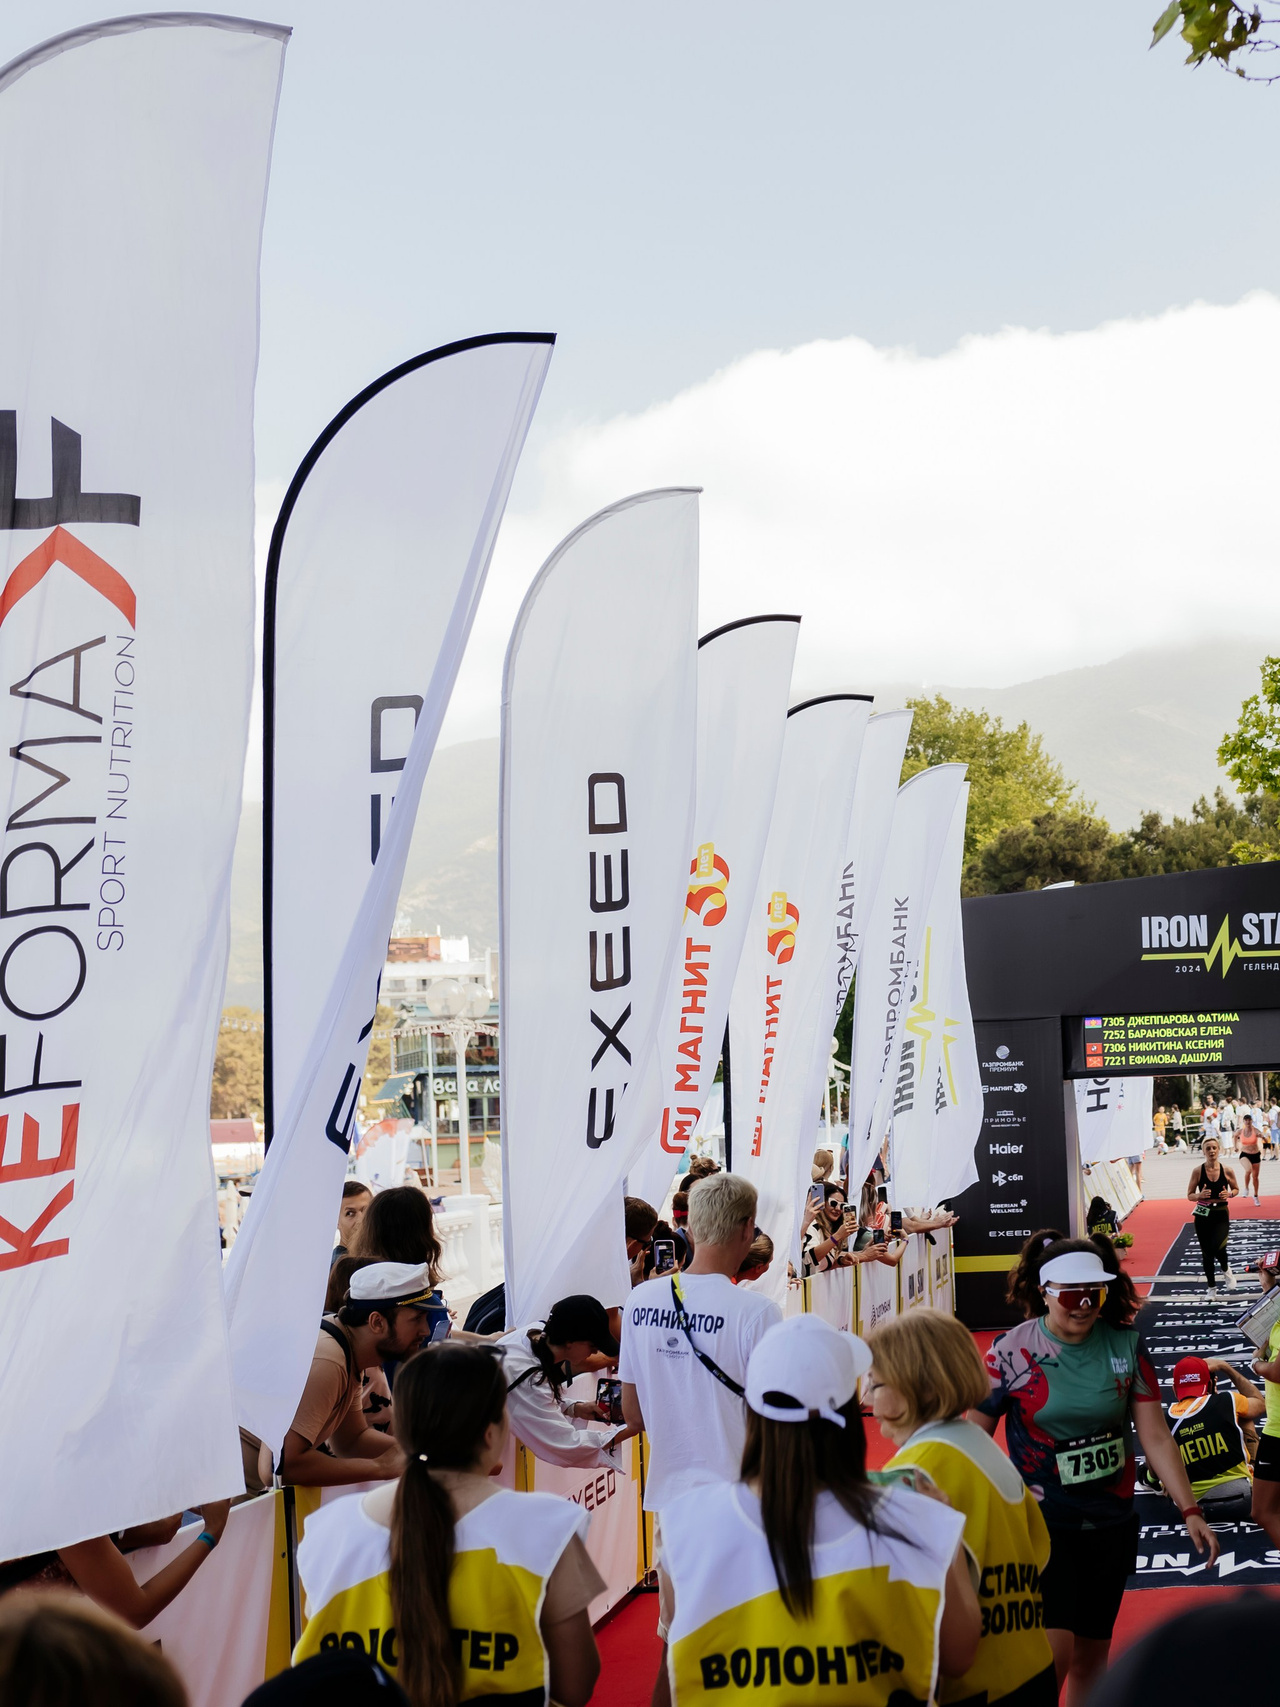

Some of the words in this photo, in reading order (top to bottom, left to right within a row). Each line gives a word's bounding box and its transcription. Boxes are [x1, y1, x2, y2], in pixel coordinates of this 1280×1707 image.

[106, 635, 136, 820] NUTRITION
[97, 831, 127, 951] SPORT
[1141, 914, 1208, 948] IRON
[1175, 965, 1201, 973] 2024
[674, 937, 711, 1092] МАГНИТ
[1102, 1017, 1125, 1027] 7305
[1127, 1014, 1195, 1028] ДЖЕППАРОВА
[1197, 1012, 1240, 1023] ФАТИМА
[1103, 1030, 1126, 1040] 7252
[1127, 1027, 1198, 1039] БАРАНОВСКАЯ
[1200, 1026, 1233, 1036] ЕЛЕНА
[1103, 1043, 1127, 1053] 7306
[1128, 1041, 1184, 1052] НИКИТИНА
[1185, 1039, 1225, 1050] КСЕНИЯ
[1104, 1056, 1126, 1066] 7221
[1129, 1054, 1178, 1065] ЕФИМОВА
[1179, 1052, 1223, 1065] ДАШУЛЯ
[989, 1142, 1024, 1155] Haier
[988, 1229, 1031, 1237] EXEED
[632, 1307, 725, 1335] ОРГАНИАТОР
[1067, 1444, 1120, 1477] 7305
[1179, 1431, 1229, 1467] MEDIA
[700, 1639, 905, 1691] ВОЛОНТЕР
